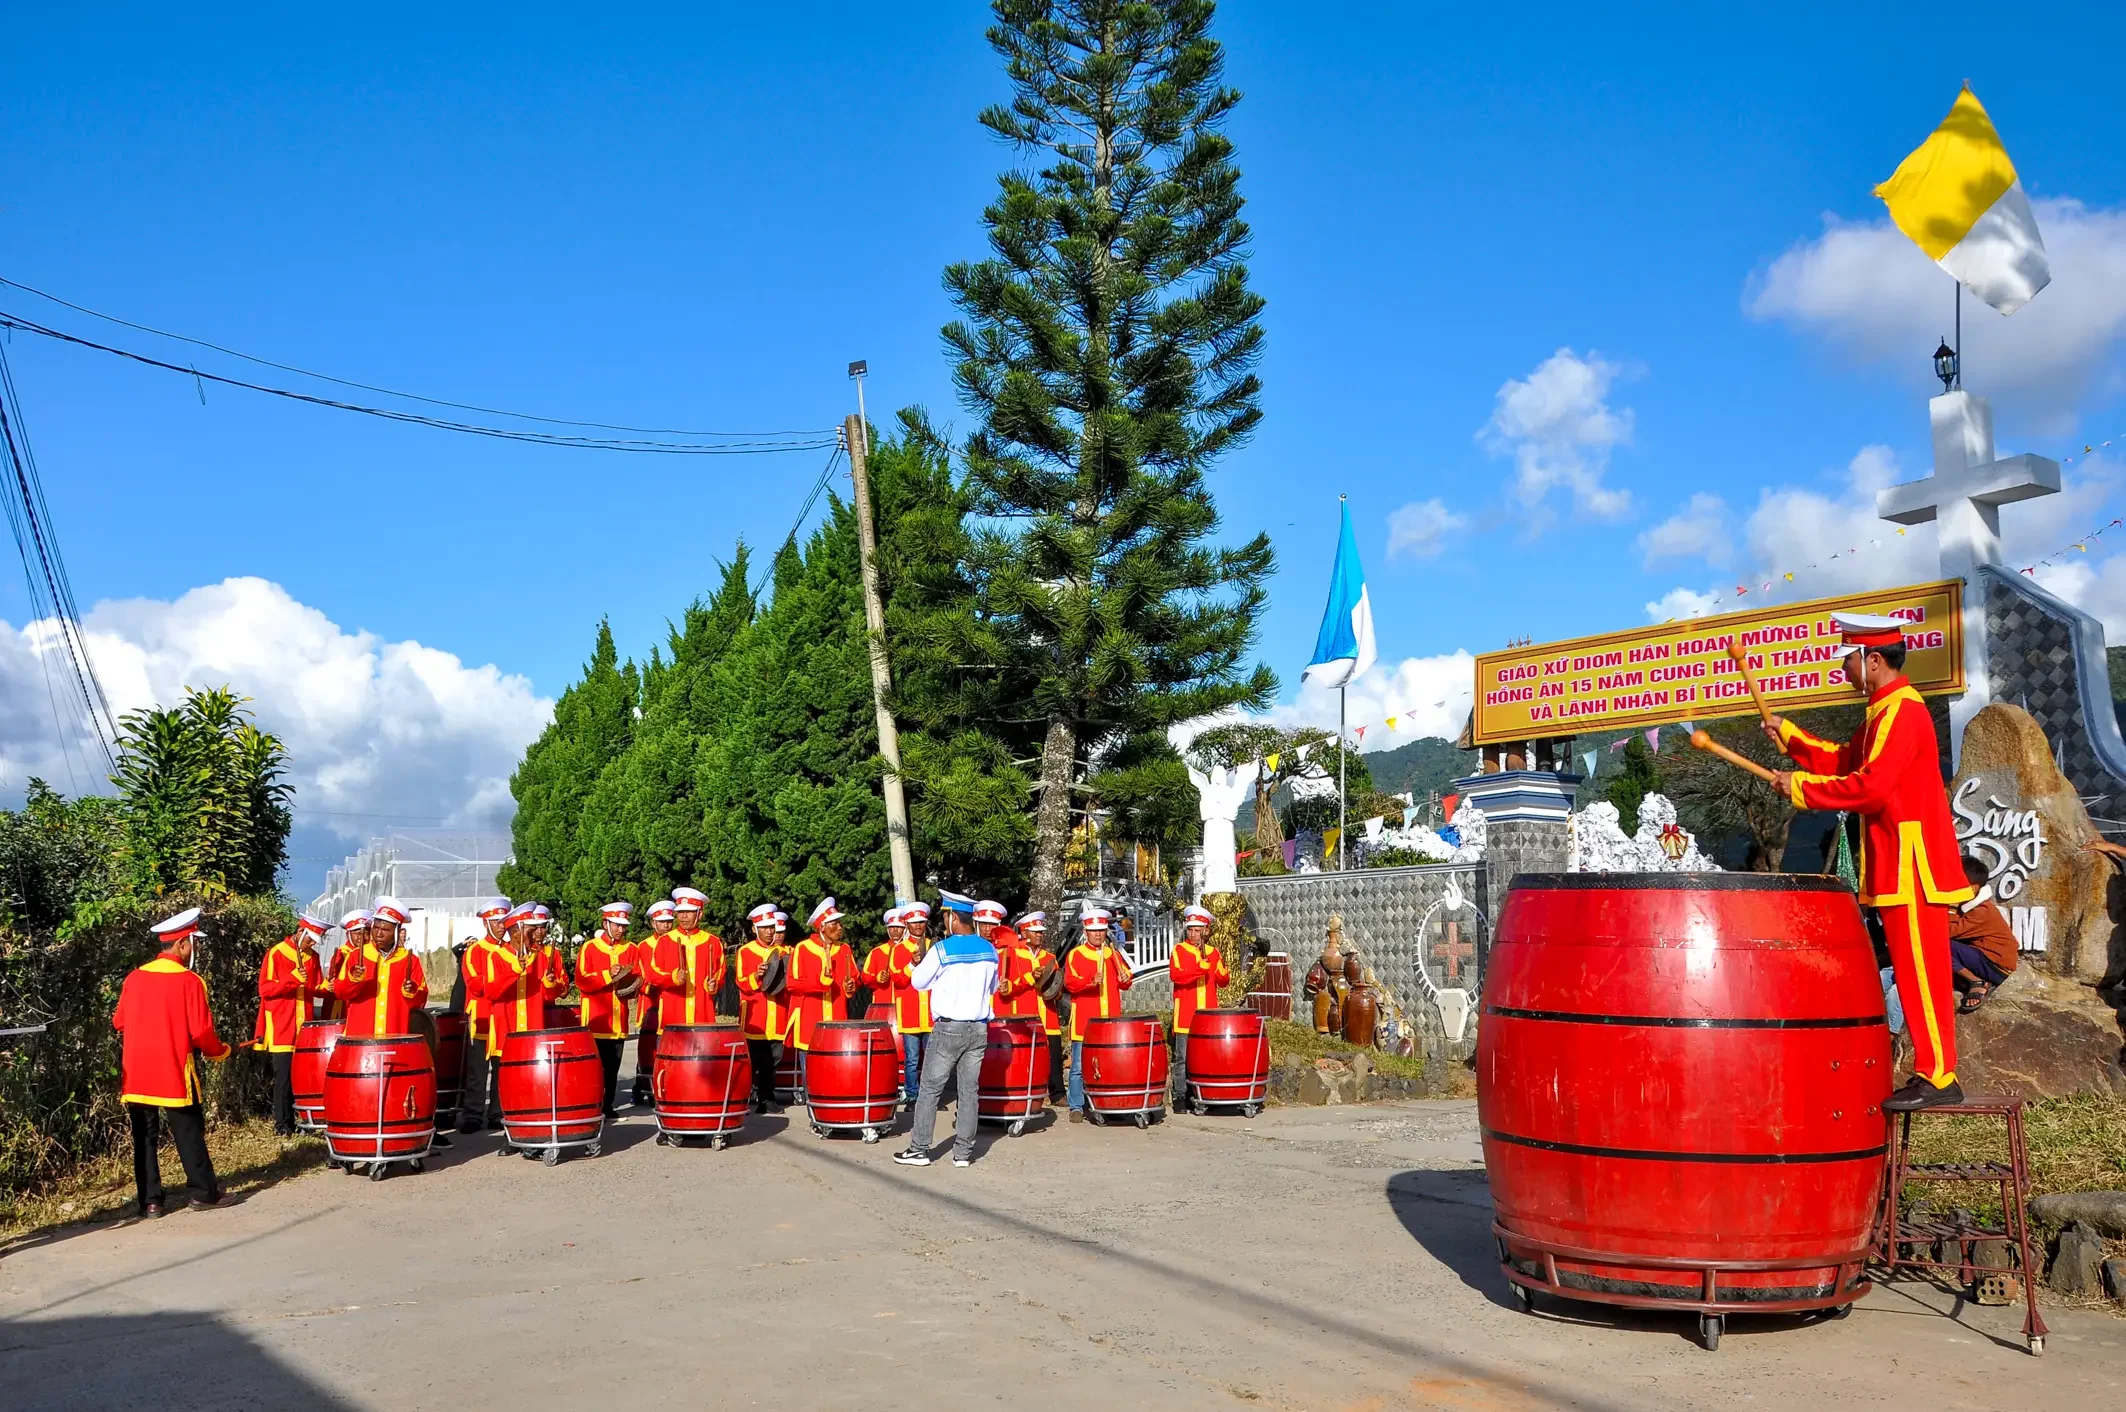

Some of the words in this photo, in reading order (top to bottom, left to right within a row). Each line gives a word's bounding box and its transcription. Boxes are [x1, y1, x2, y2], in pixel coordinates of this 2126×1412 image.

[1486, 686, 1533, 705] HỒNG
[1539, 682, 1564, 698] ÂN
[1570, 679, 1592, 693] 15
[1598, 671, 1643, 690] NĂM
[1650, 662, 1705, 682] CUNG
[1771, 644, 1840, 667] THÁN
[1498, 662, 1538, 682] GIÁO
[1544, 657, 1569, 676] XỨ
[1574, 652, 1622, 671] DIOM
[1629, 644, 1669, 662] HÂN
[1676, 635, 1733, 656] HOAN
[1741, 625, 1808, 646] MỪNG
[1530, 703, 1553, 720] VÀ
[1559, 698, 1607, 717] LÃNH
[1613, 691, 1669, 711] NHẬN
[1675, 684, 1697, 703] BÍ
[1702, 680, 1750, 699] TÍCH
[1757, 672, 1820, 693] THÊM
